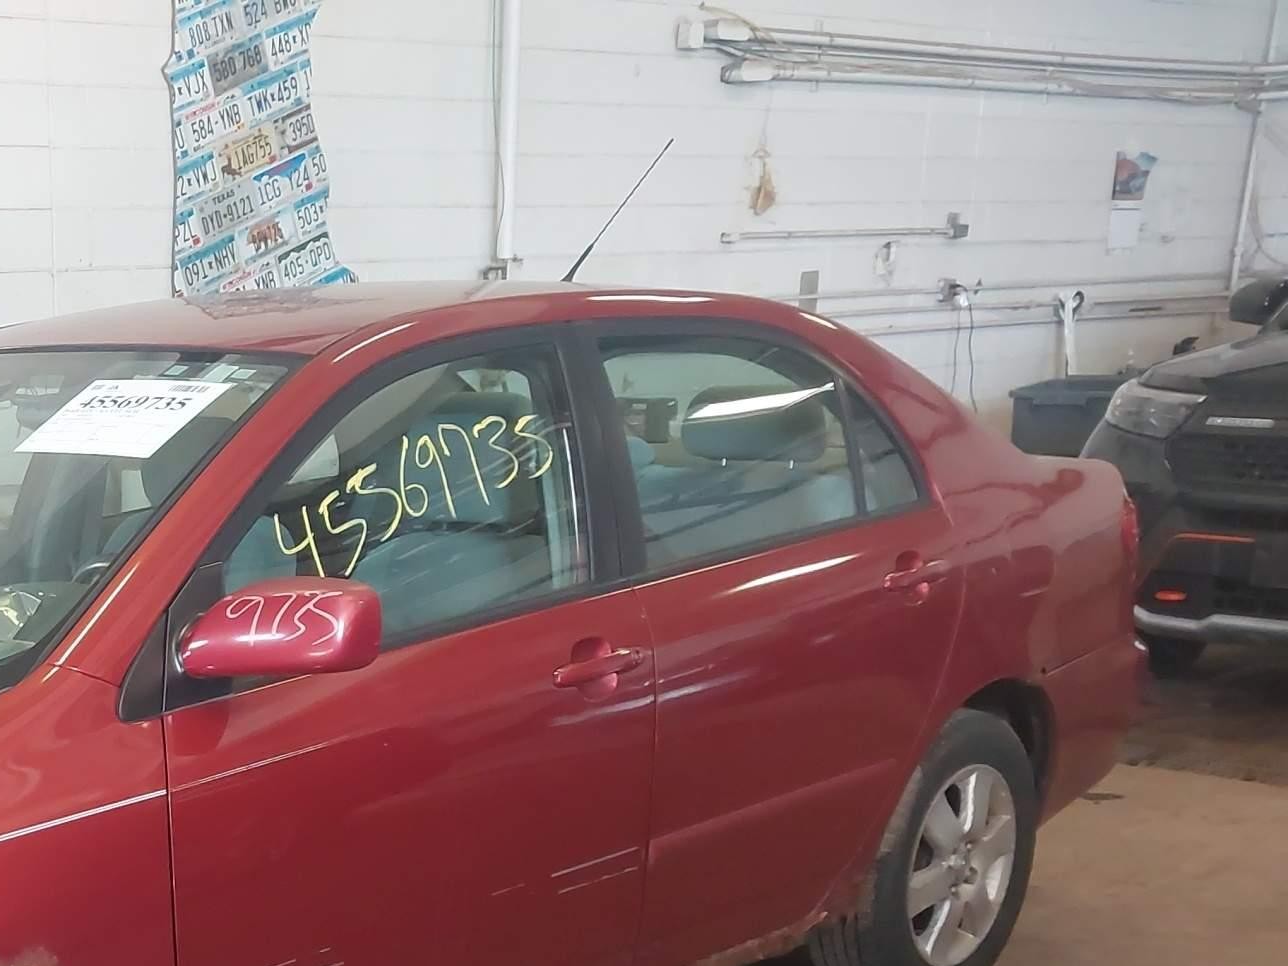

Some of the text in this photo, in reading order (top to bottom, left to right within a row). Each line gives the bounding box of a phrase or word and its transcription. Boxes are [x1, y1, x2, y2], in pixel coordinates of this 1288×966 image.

[212, 189, 235, 206] TEXAS
[80, 395, 192, 411] 45569735
[272, 414, 554, 579] 45569735
